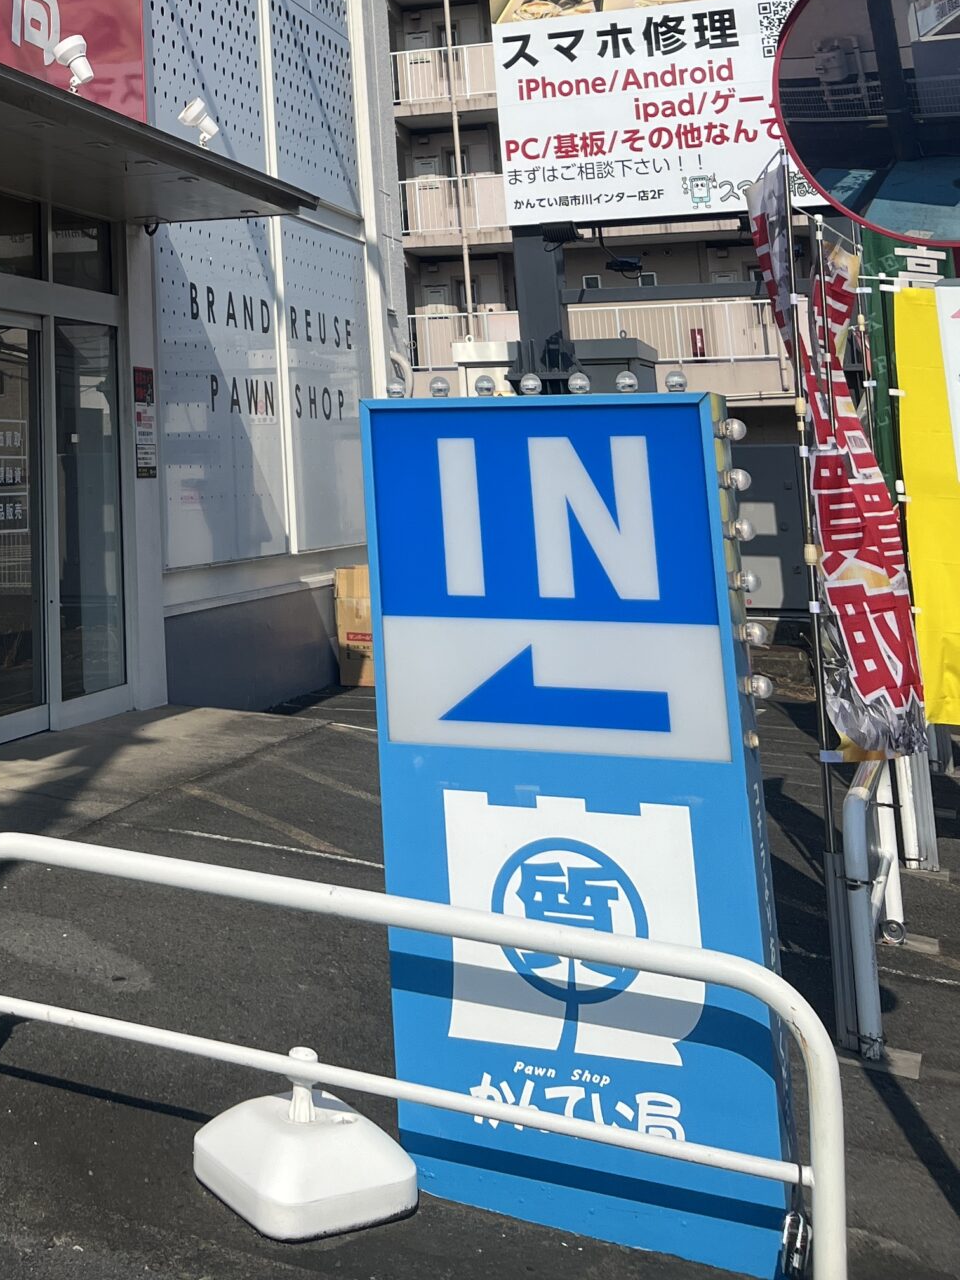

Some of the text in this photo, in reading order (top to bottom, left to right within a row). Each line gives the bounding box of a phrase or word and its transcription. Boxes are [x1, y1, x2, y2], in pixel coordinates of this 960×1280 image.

[502, 8, 740, 70] スマホ修理
[518, 57, 734, 101] iPhone/Android
[634, 87, 776, 122] ipad/ゲー
[513, 188, 665, 210] かんてい局市川インター店2F
[189, 282, 353, 351] BRAND REUSE
[210, 373, 345, 421] PAWN SHOP
[437, 435, 661, 601] IN
[513, 1061, 611, 1087] Pawn Shop
